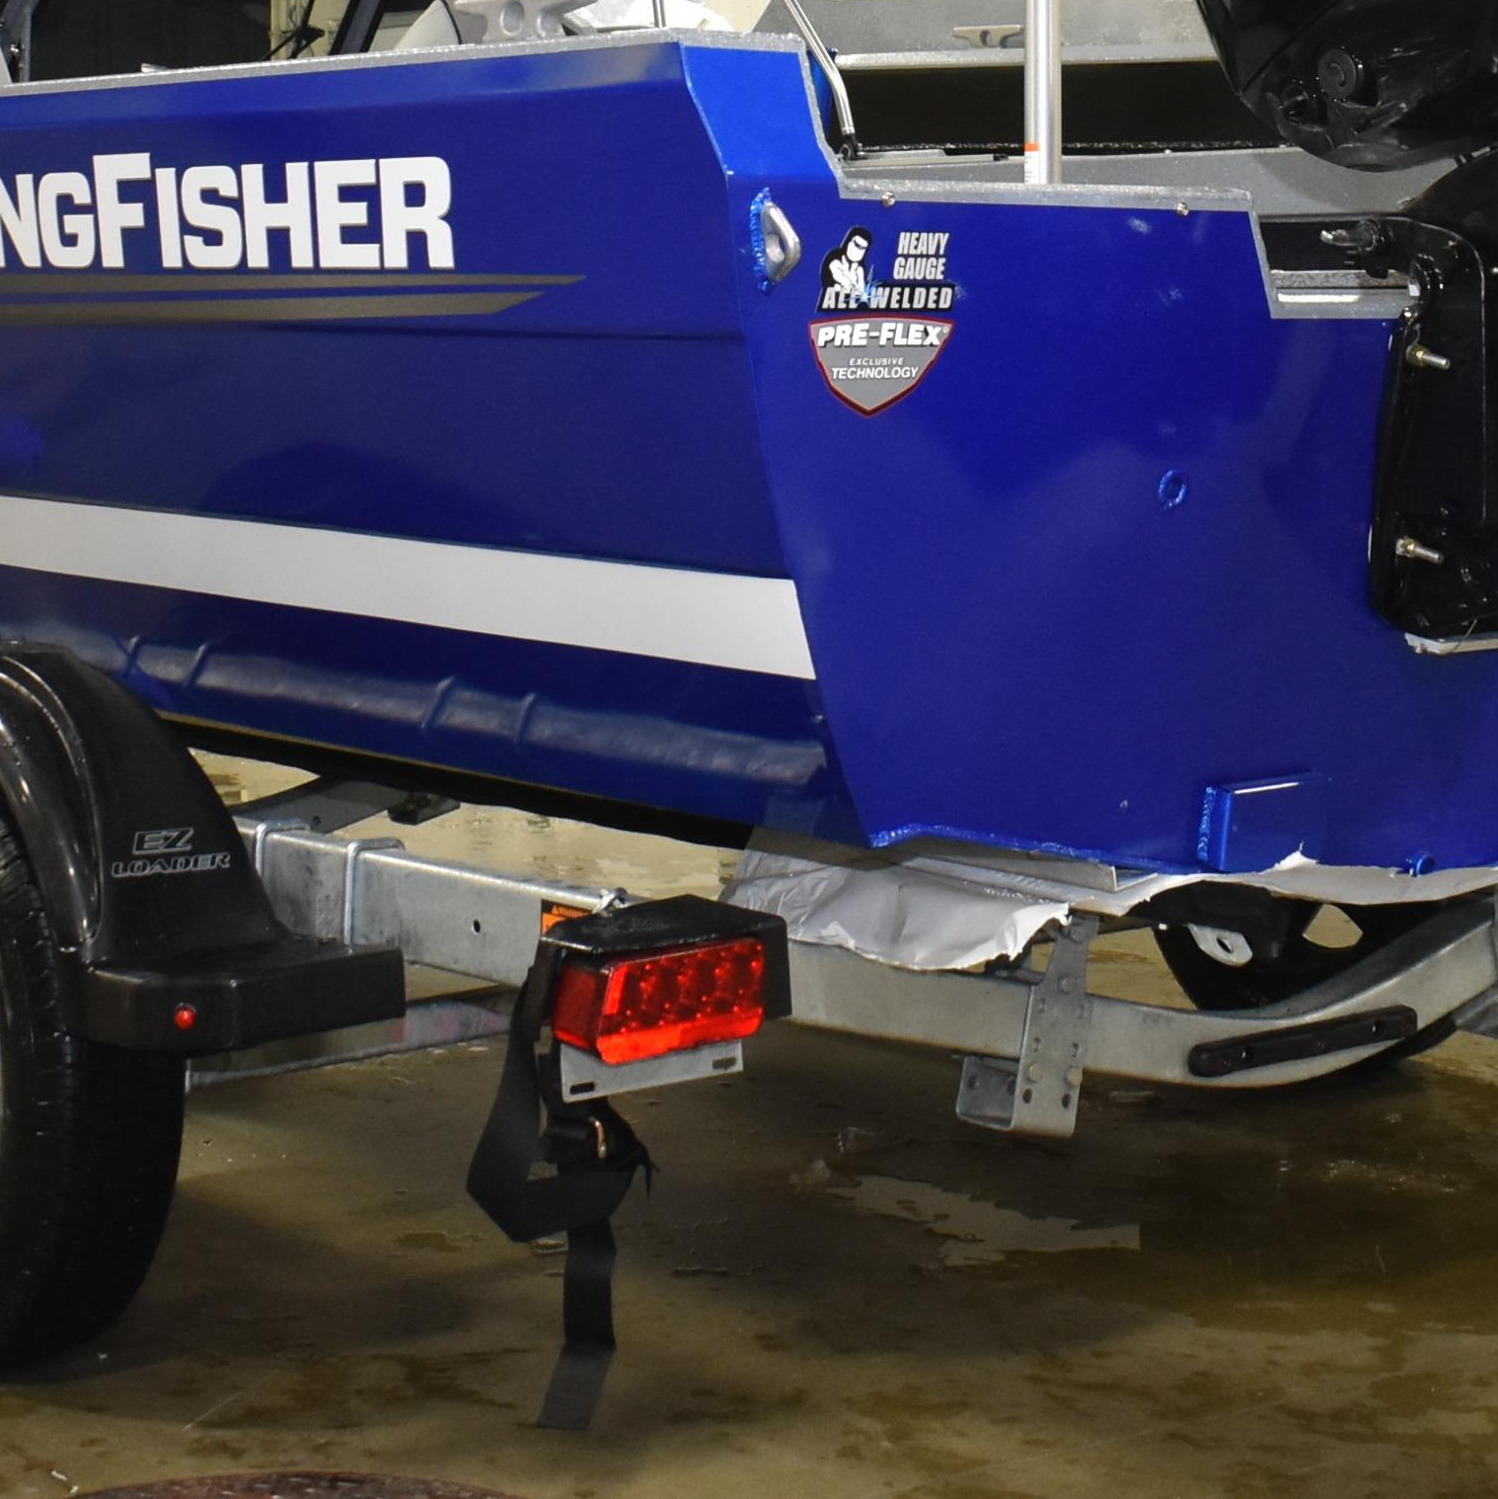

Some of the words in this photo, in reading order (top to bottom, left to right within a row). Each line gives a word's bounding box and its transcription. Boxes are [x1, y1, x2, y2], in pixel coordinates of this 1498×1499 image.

[897, 231, 950, 255] HEAVY
[892, 257, 947, 280] GAUGE
[869, 286, 953, 310] WELDED
[817, 322, 943, 348] PRE-FLEX
[831, 366, 920, 380] TECHNOLOGY
[848, 357, 904, 366] EXCLUSIVE
[132, 826, 195, 856] EZ
[110, 851, 232, 878] LOADER
